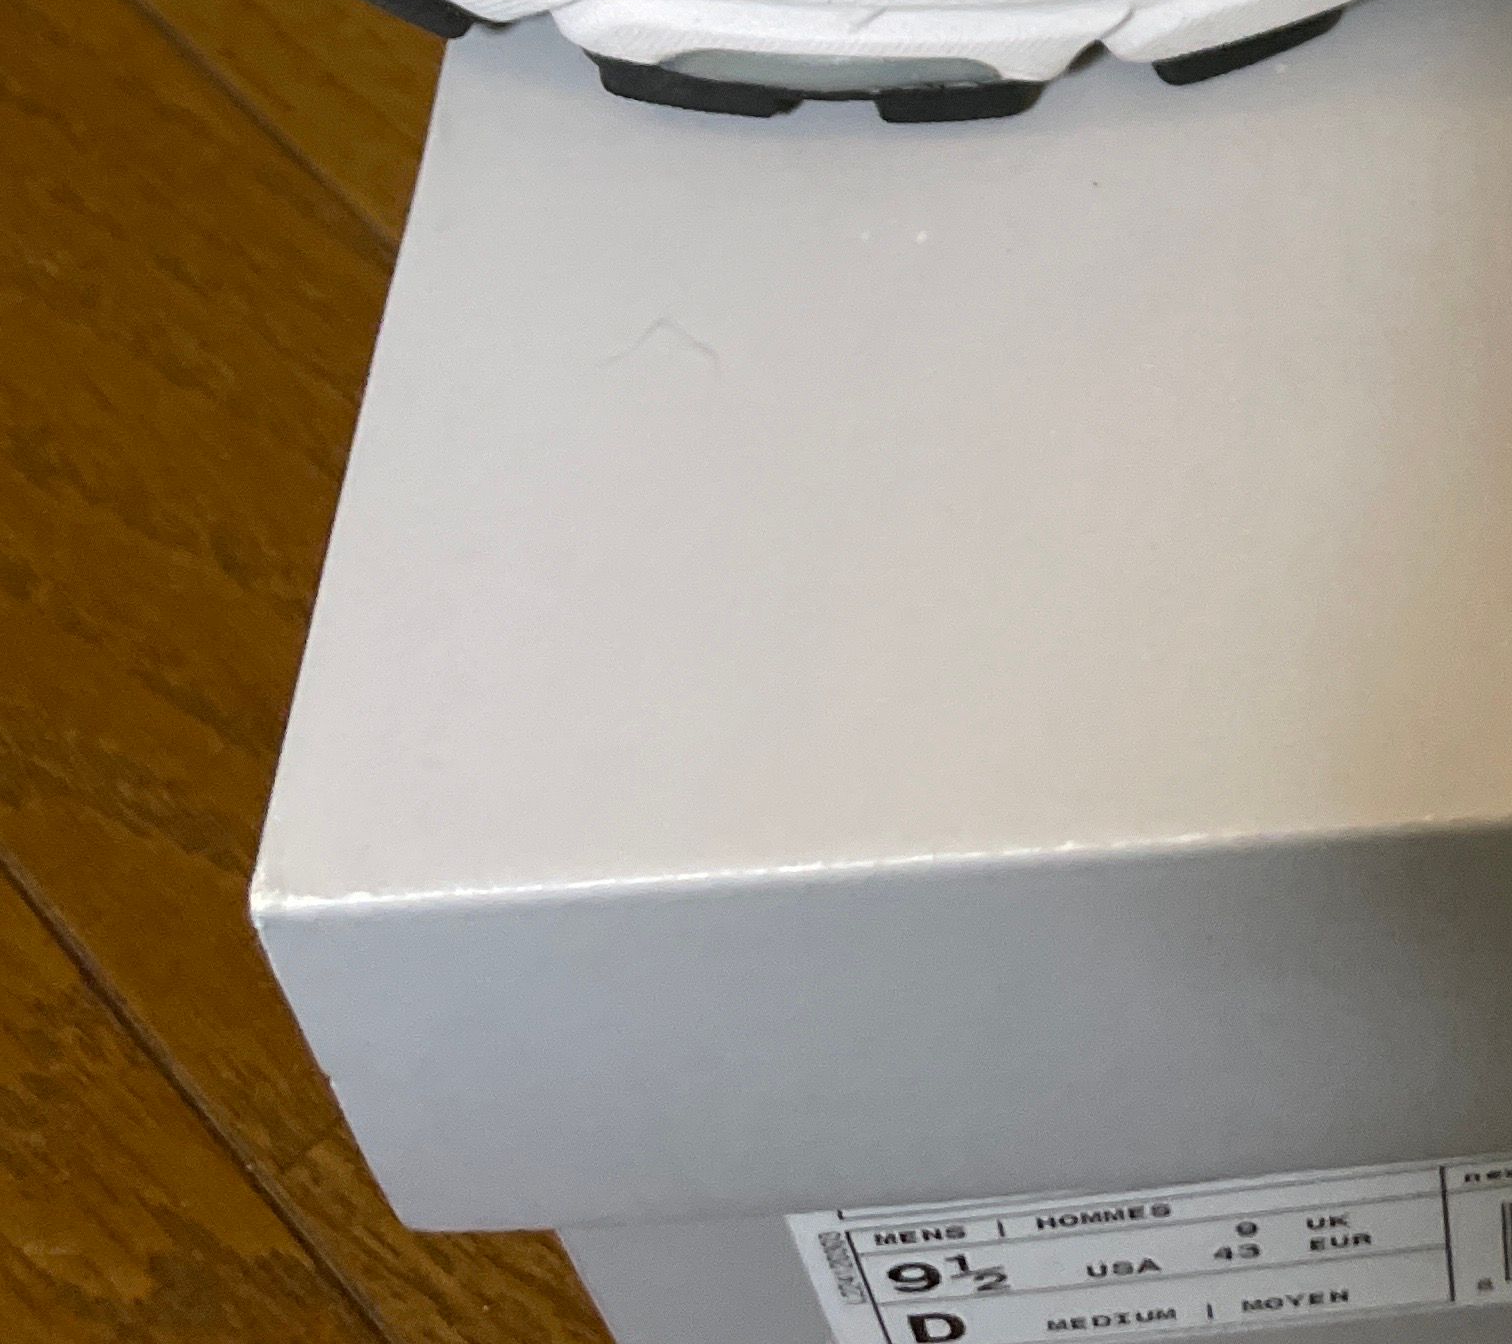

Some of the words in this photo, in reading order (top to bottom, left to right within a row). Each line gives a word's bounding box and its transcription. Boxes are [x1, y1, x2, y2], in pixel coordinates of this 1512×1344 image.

[873, 1224, 967, 1246] MENS
[1035, 1202, 1172, 1230] HOMMES
[1306, 1214, 1348, 1230] UK
[1213, 1242, 1261, 1261] 43
[1309, 1232, 1372, 1251] EUR
[1085, 1257, 1163, 1279] USA
[1047, 1307, 1177, 1332] MEDIUM
[1241, 1288, 1349, 1313] MOYEN
[907, 1311, 967, 1343] D
